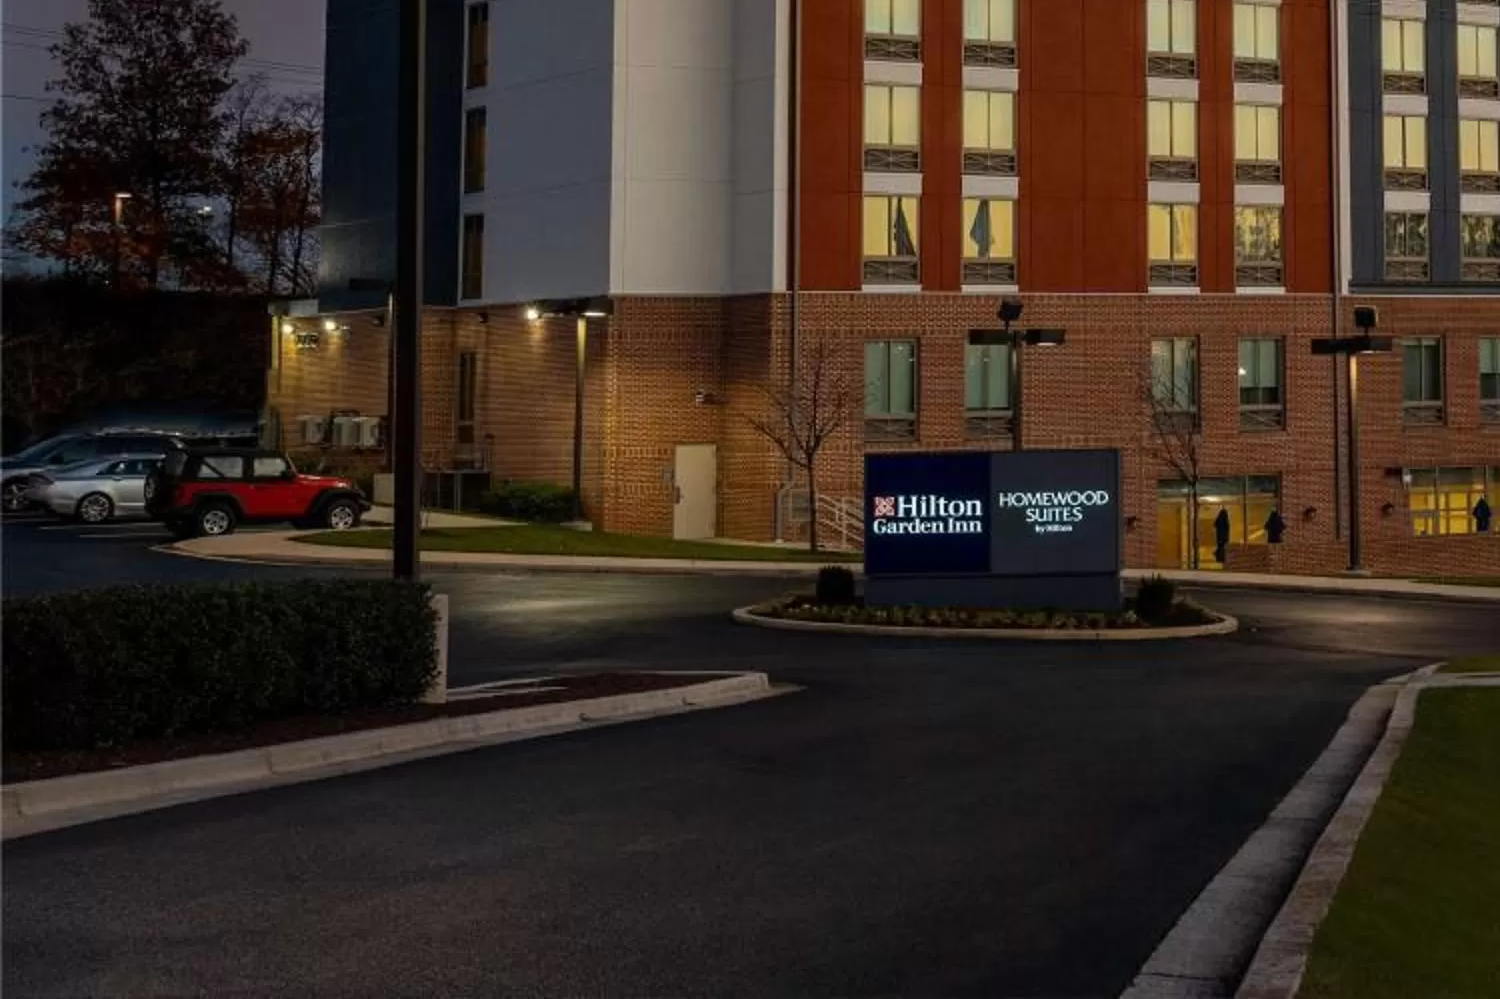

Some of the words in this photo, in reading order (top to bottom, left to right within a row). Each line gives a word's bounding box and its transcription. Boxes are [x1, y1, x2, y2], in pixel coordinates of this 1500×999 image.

[897, 495, 983, 518] Hilton
[999, 490, 1109, 508] HOMEWOOD
[1025, 507, 1083, 522] SUITES
[873, 518, 944, 534] Garden
[947, 518, 983, 534] Inn
